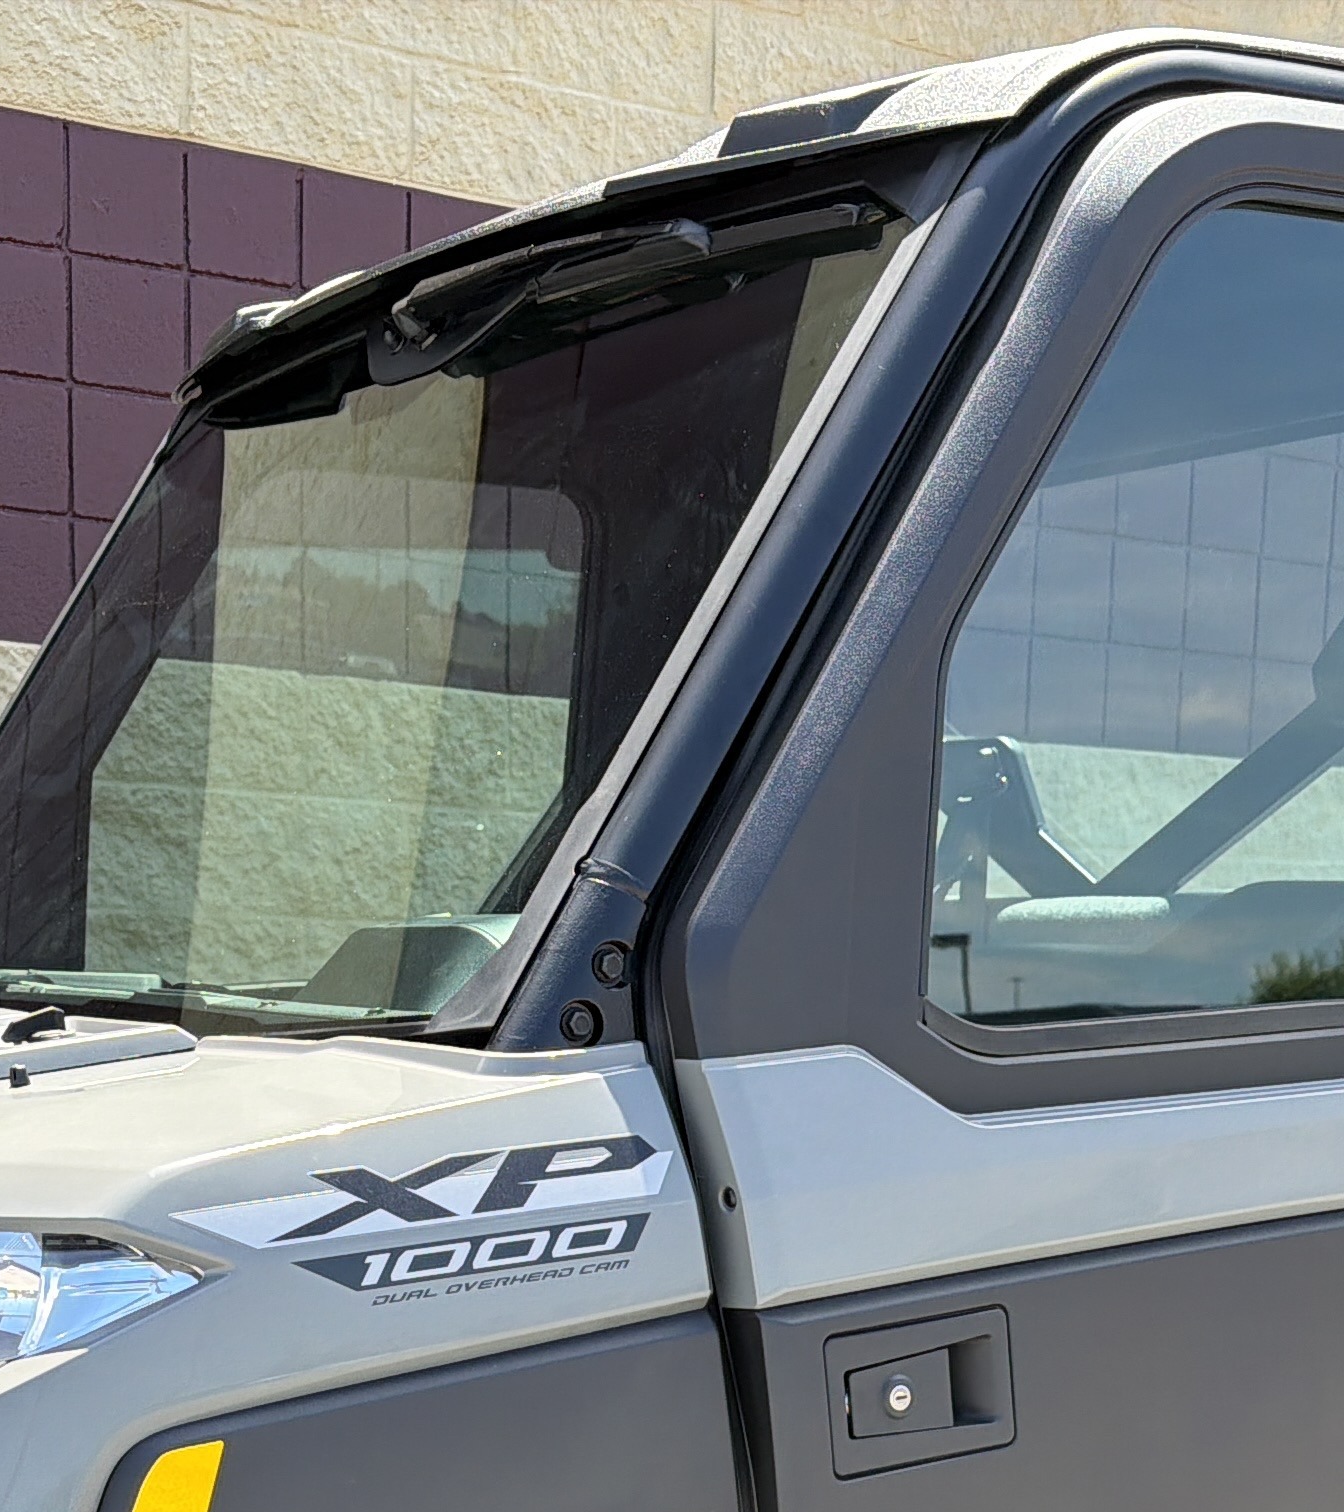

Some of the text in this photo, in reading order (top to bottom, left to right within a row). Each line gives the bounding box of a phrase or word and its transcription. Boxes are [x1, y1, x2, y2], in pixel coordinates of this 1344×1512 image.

[266, 1135, 656, 1243] XP
[360, 1219, 628, 1287] 1000
[371, 1258, 631, 1307] DUAL OVERHEAD CAM
